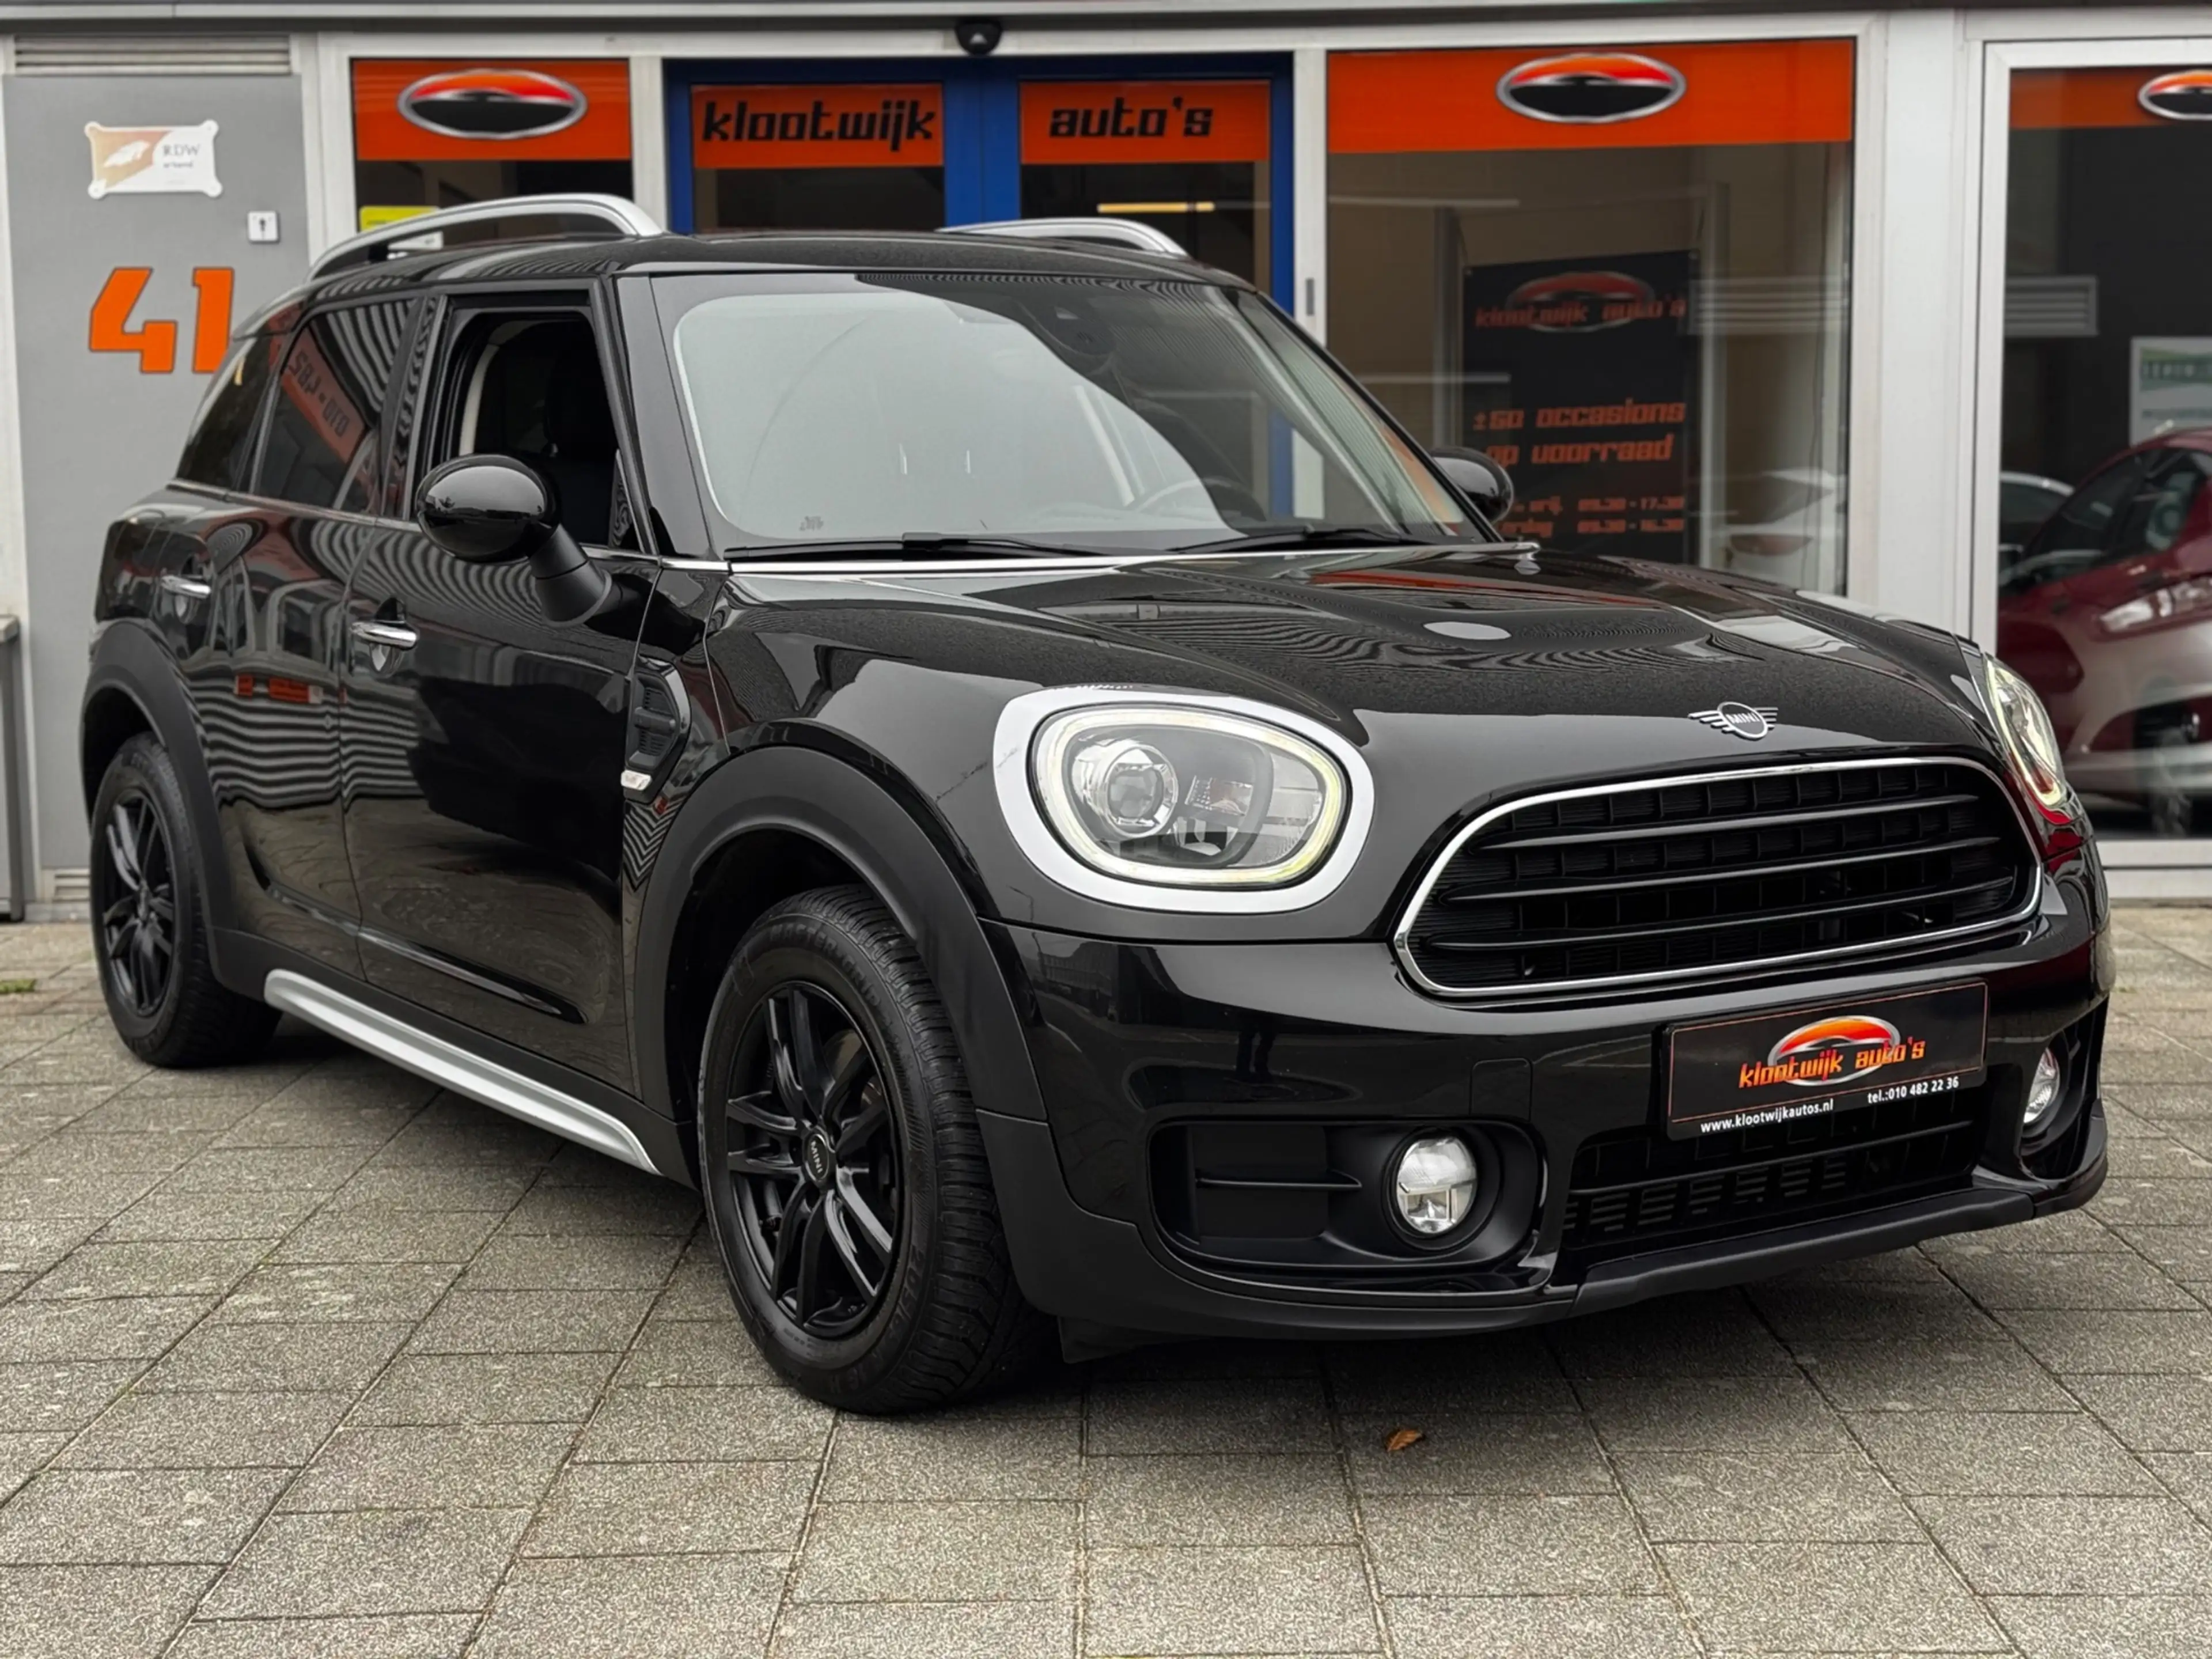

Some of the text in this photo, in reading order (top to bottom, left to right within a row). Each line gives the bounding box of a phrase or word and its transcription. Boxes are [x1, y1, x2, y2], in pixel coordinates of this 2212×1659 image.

[702, 100, 936, 152] klootwijk
[1049, 96, 1214, 138] auto's
[163, 144, 201, 156] RDW
[89, 267, 234, 373] 41
[1536, 397, 1686, 428] occasions
[1486, 432, 1674, 467] op voorraad
[1725, 712, 1760, 724] MINI
[1738, 1037, 1926, 1088] klootwijk auto's
[1910, 1082, 1929, 1095] 482
[1931, 1079, 1944, 1092] 22
[1946, 1076, 1959, 1090] 36
[1700, 1098, 1834, 1132] www.klootwijkautos.nl
[810, 1140, 824, 1174] MINI
